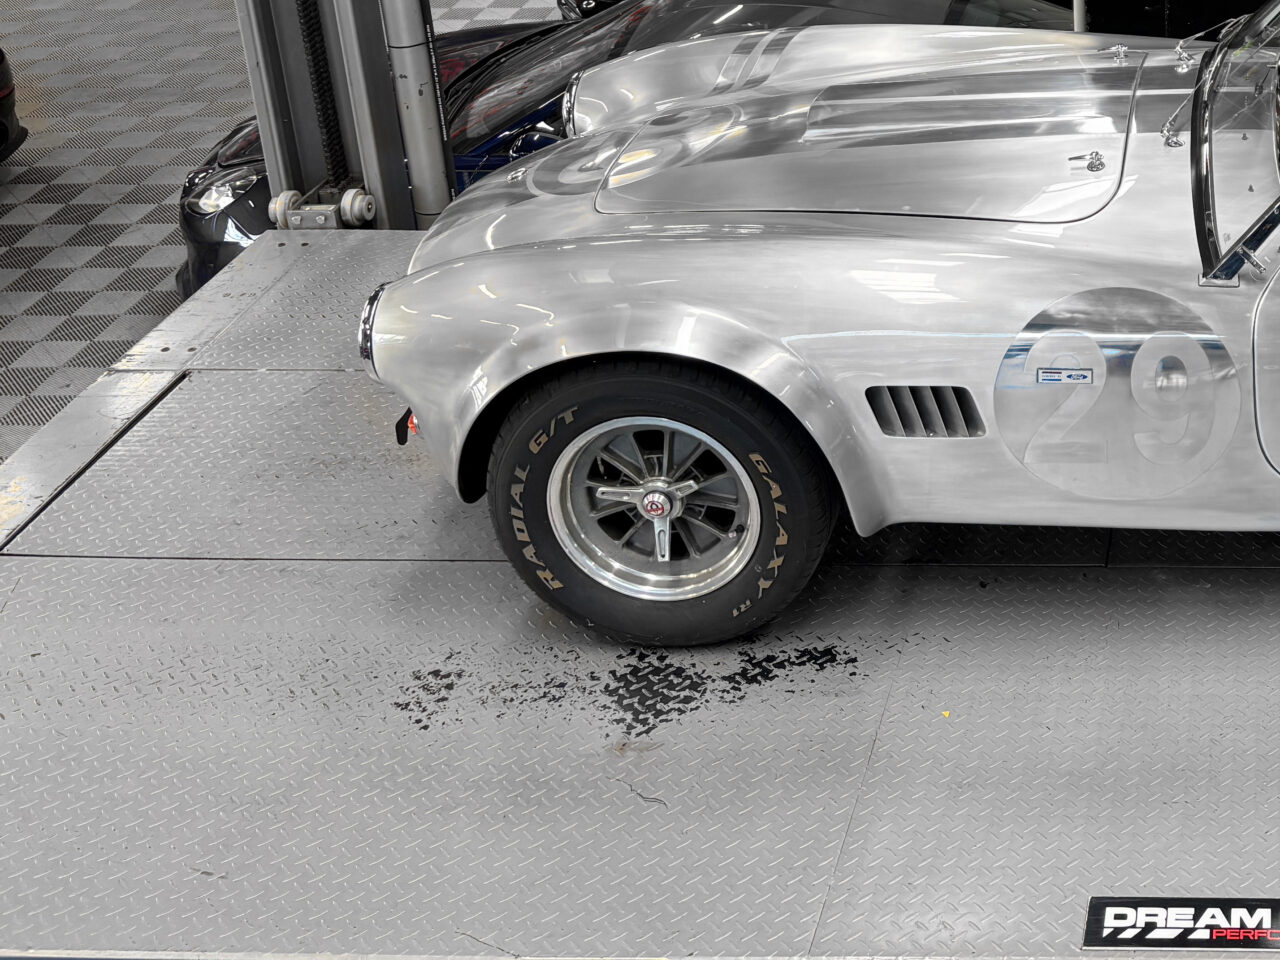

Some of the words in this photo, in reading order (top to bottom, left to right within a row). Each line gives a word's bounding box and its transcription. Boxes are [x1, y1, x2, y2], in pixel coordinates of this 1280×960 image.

[1023, 328, 1216, 465] 29
[510, 463, 565, 591] RADIAL
[748, 452, 789, 599] GALAXY
[1103, 906, 1272, 929] DREAM
